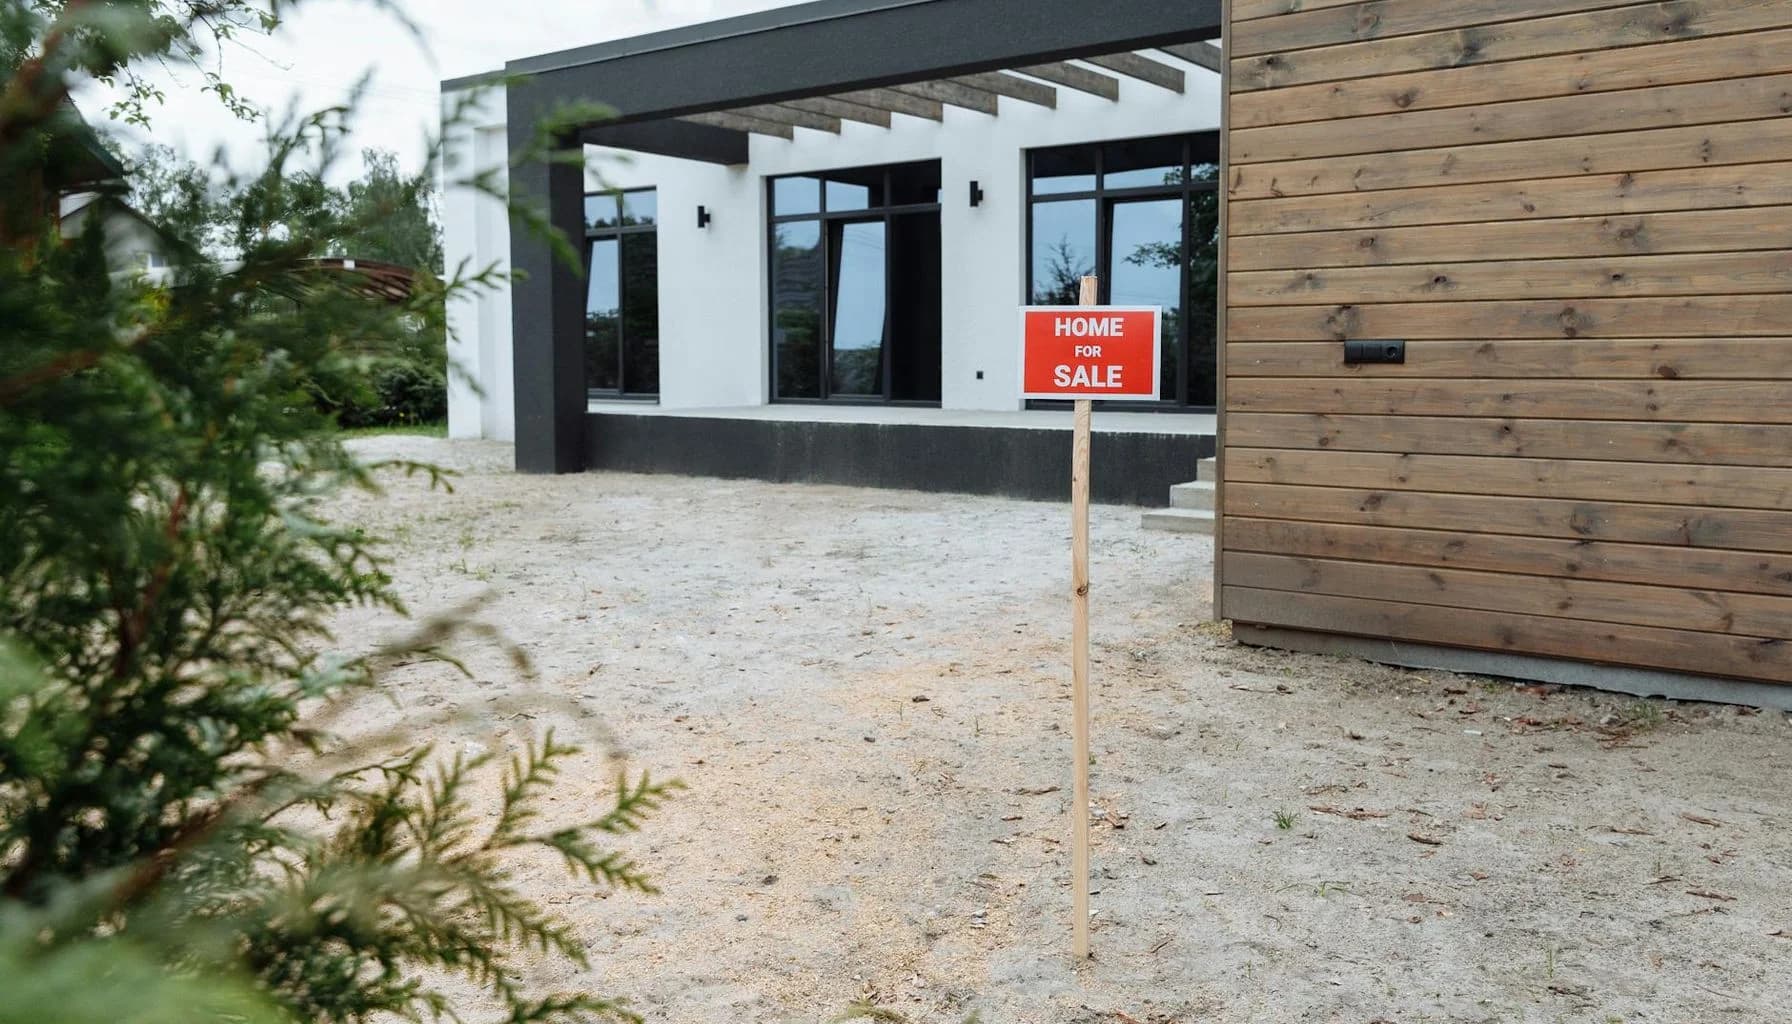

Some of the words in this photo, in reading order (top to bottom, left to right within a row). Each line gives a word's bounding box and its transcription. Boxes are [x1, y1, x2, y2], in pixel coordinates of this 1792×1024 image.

[1054, 317, 1124, 337] HOME
[1074, 345, 1102, 358] FOR
[1053, 364, 1123, 388] SALE
